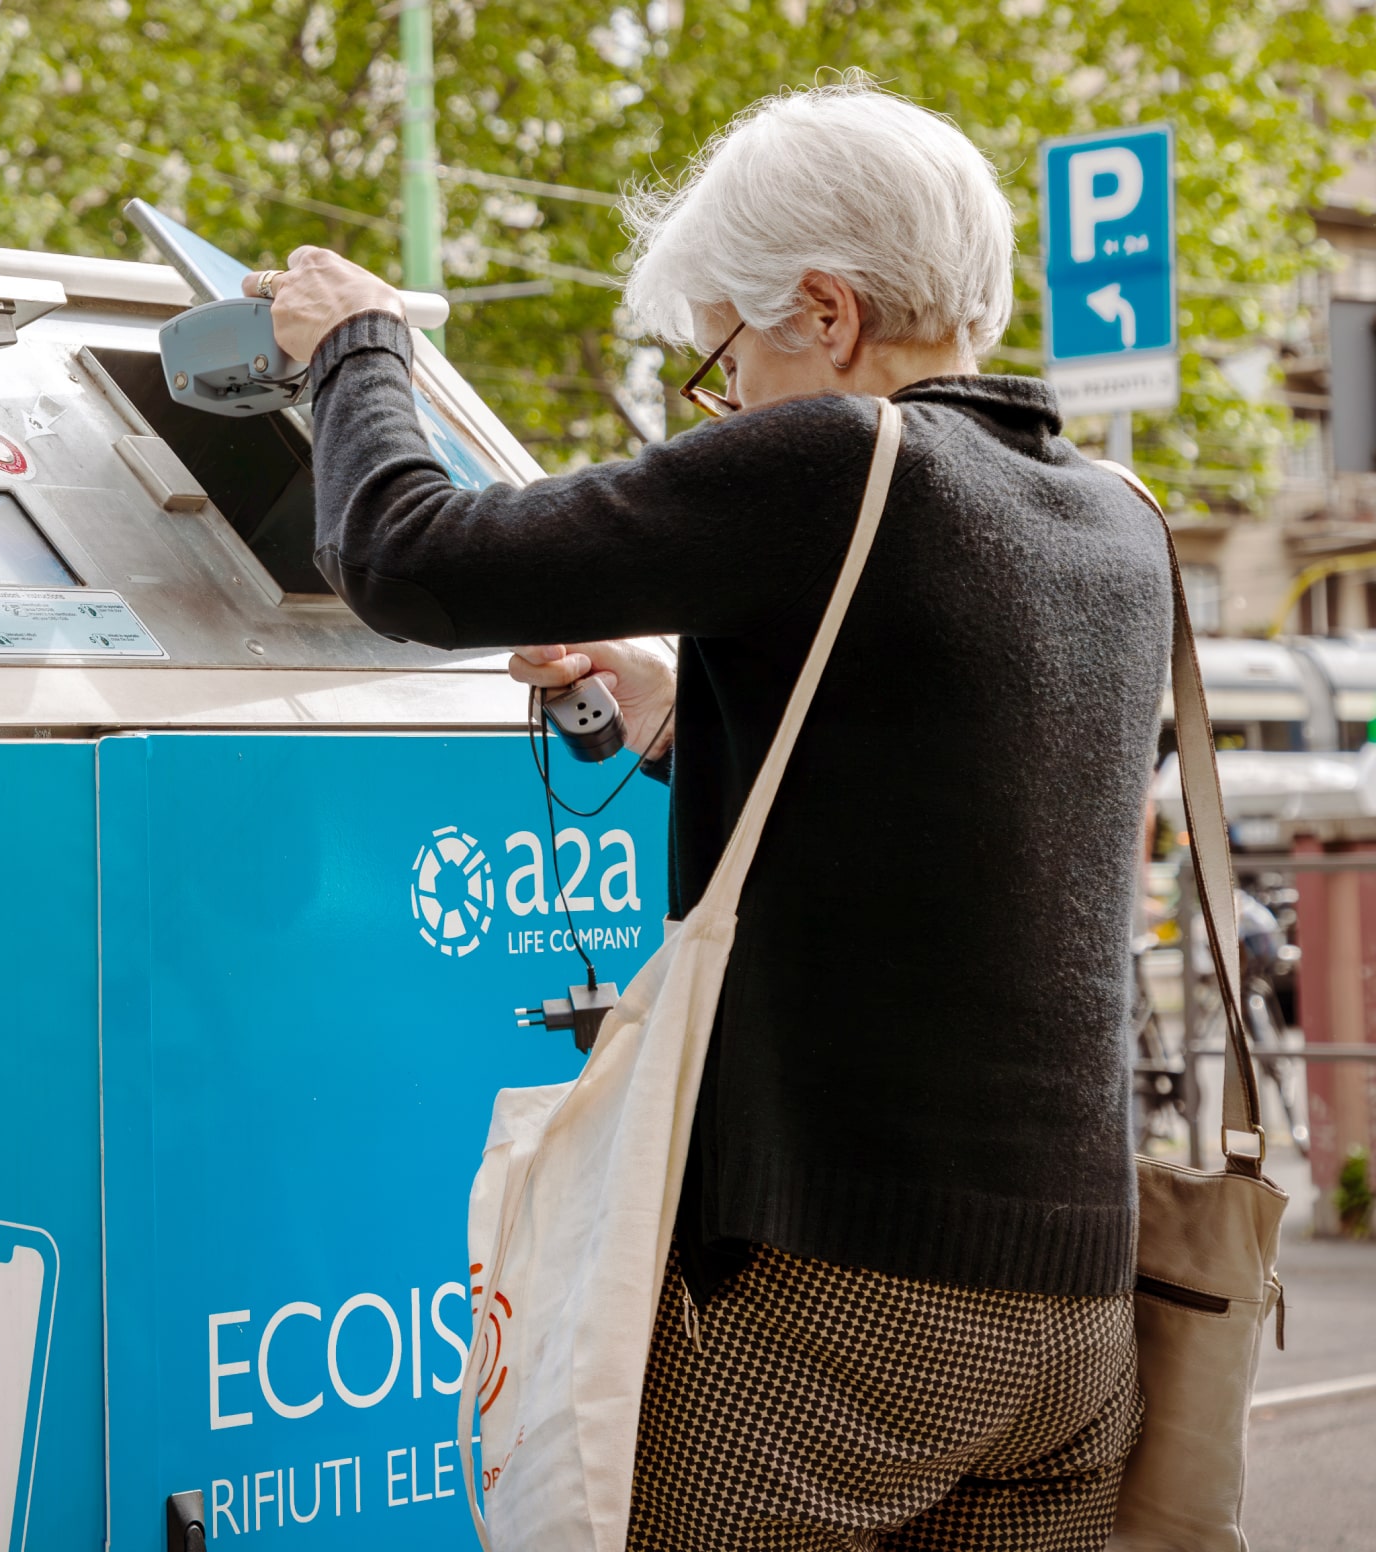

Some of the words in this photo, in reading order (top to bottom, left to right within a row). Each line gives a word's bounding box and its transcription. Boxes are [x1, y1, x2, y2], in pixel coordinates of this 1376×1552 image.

[1068, 147, 1144, 263] P
[505, 827, 641, 916] a2a
[508, 930, 544, 955] LIFE
[549, 926, 642, 952] COMPANY
[209, 1281, 469, 1431] ECOIS
[211, 1456, 361, 1539] RIFIUTI
